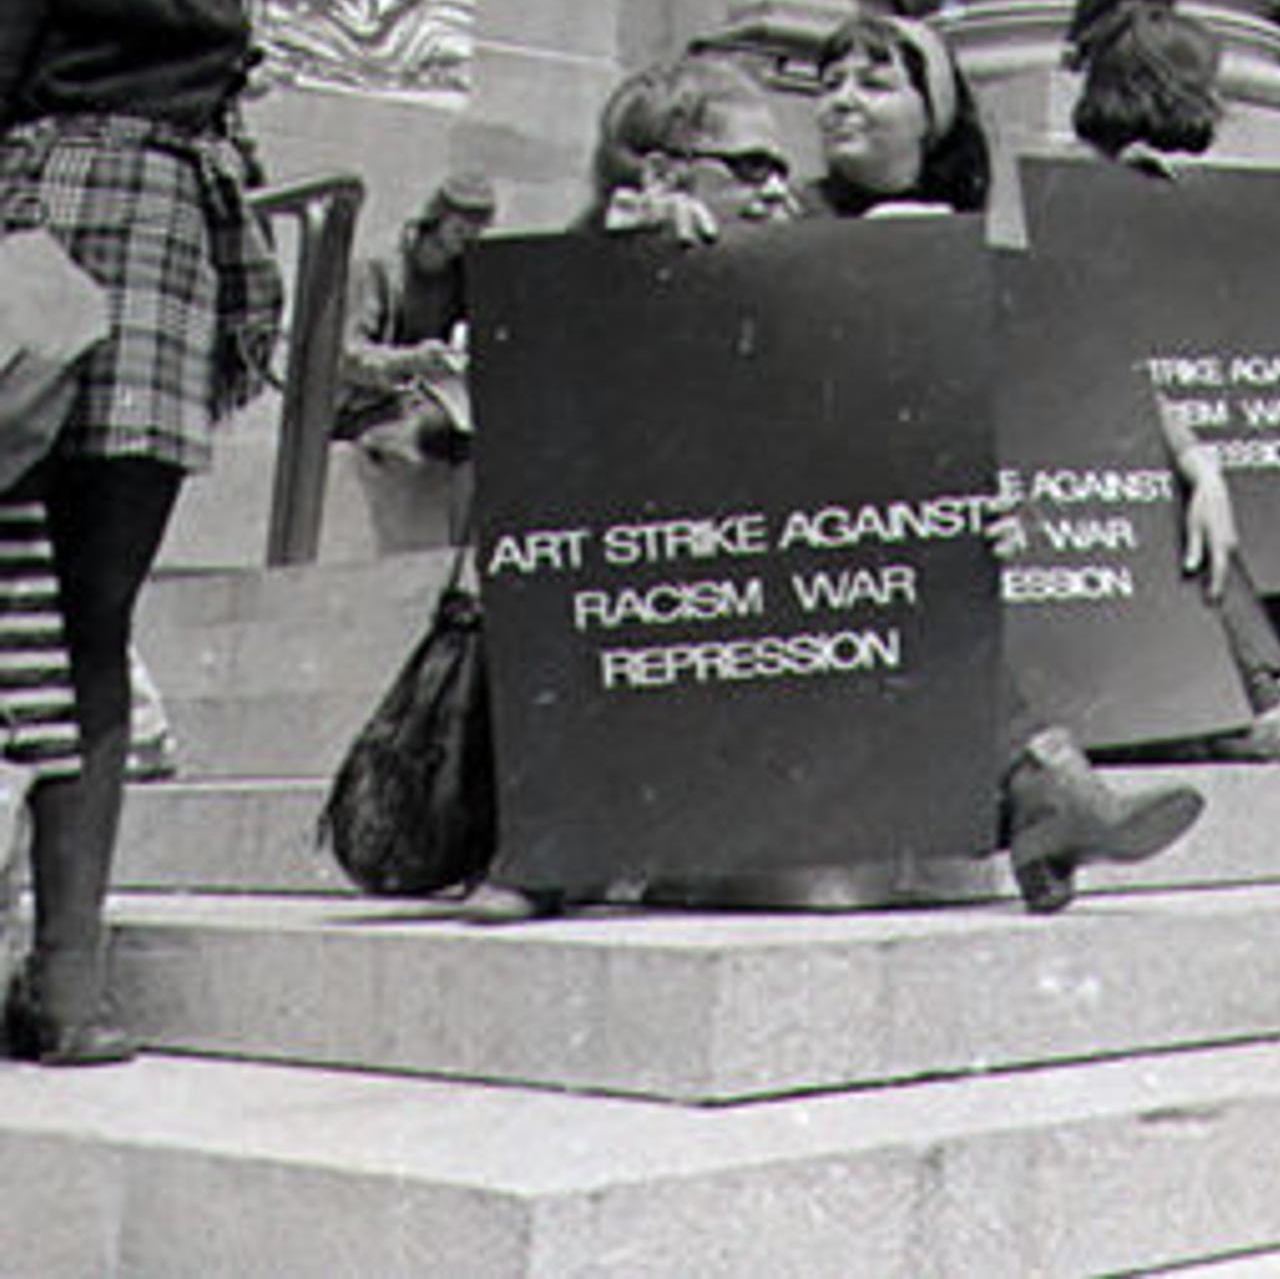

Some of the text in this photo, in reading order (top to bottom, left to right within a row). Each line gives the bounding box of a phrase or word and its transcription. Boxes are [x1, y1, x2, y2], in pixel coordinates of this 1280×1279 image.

[1030, 469, 1173, 503] AGAINST
[488, 530, 591, 575] ART
[603, 514, 768, 564] STRIKE
[778, 494, 988, 550] AGAINST
[1043, 517, 1138, 551] WAR
[572, 564, 917, 631] RACISM WAR
[1001, 566, 1134, 602] ESSION
[602, 627, 901, 689] REPRESSION
